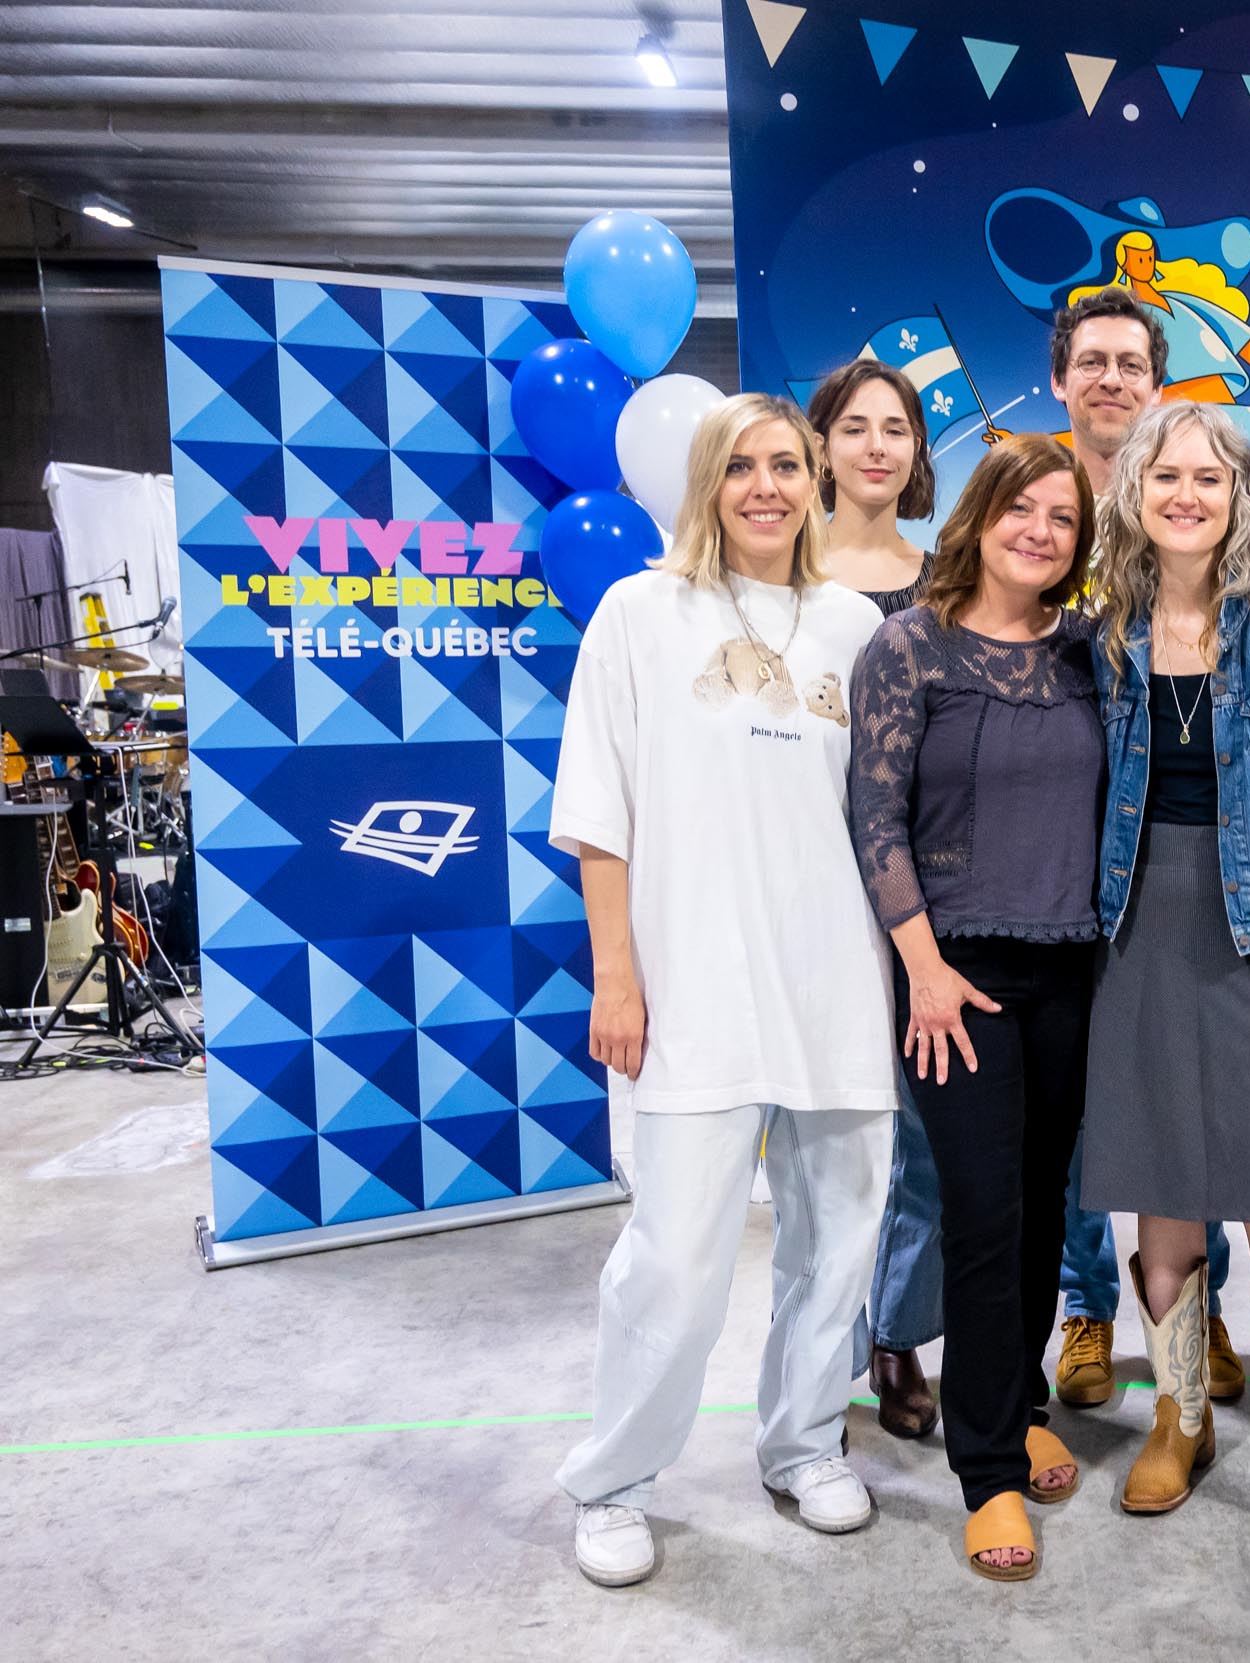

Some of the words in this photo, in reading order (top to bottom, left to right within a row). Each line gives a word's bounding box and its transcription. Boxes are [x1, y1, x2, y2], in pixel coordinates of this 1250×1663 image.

[243, 515, 524, 575] VIVEZ
[266, 618, 538, 659] TÉLÉ-QUÉBEC
[751, 726, 772, 737] Palm
